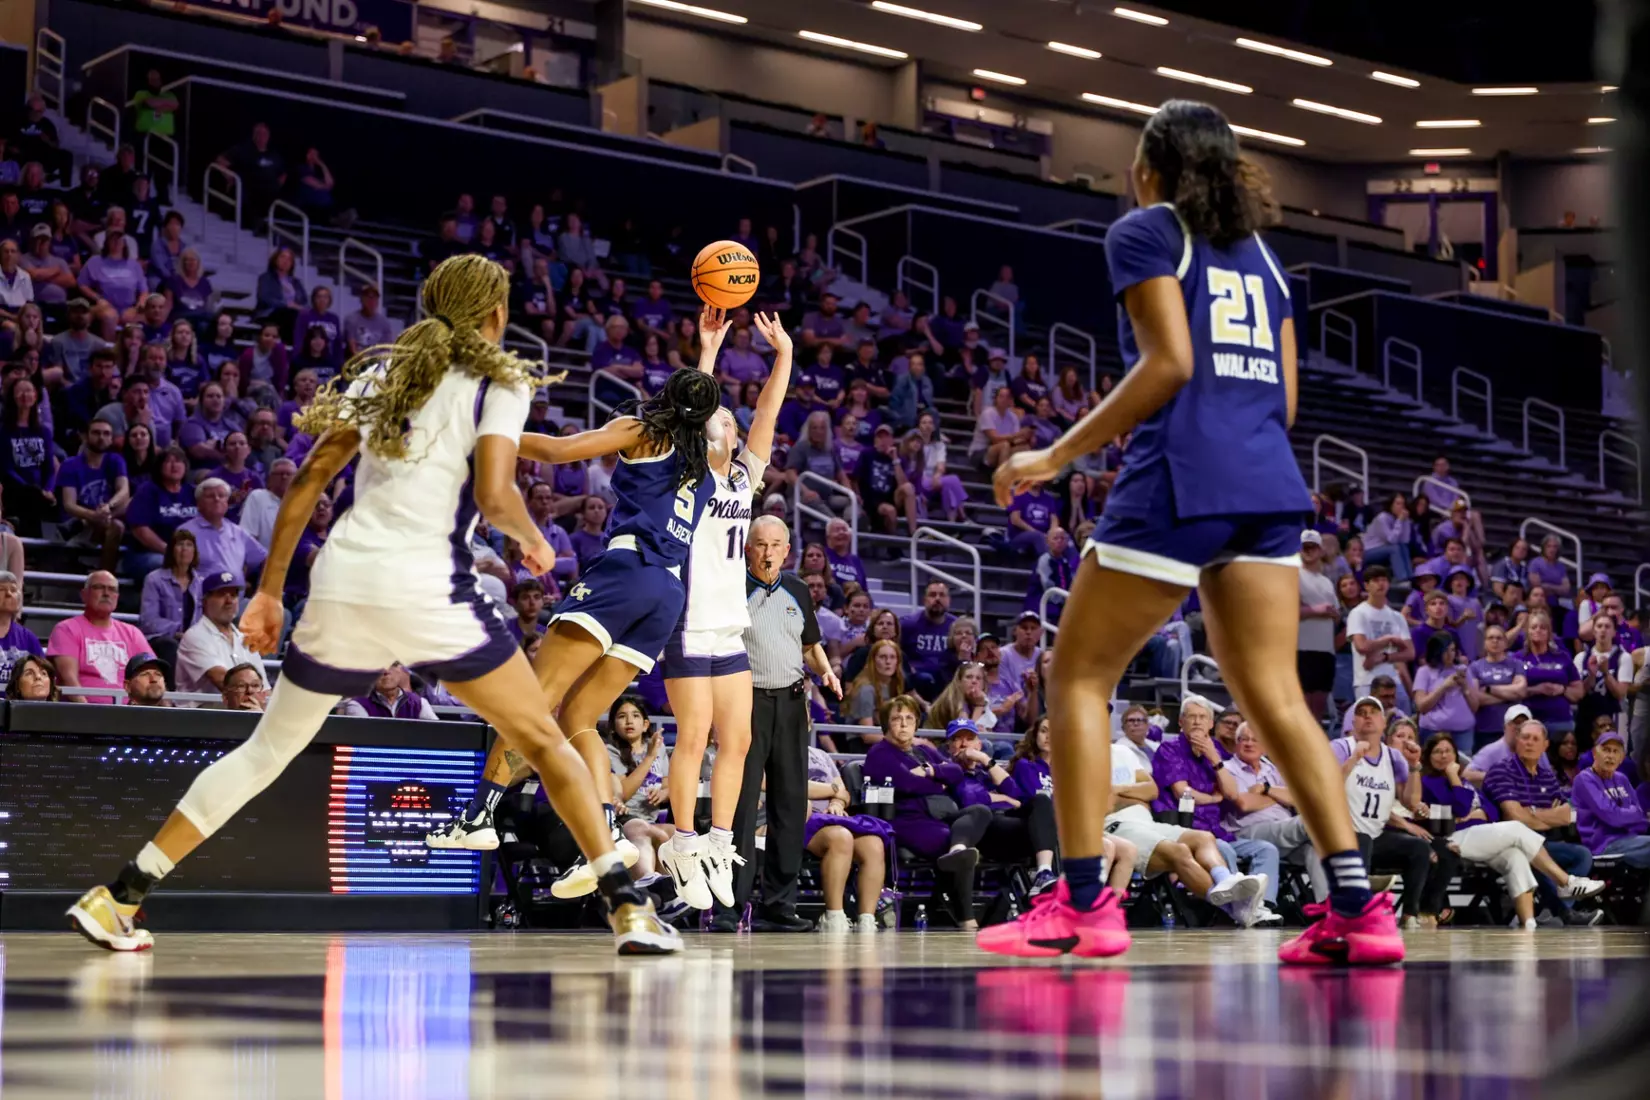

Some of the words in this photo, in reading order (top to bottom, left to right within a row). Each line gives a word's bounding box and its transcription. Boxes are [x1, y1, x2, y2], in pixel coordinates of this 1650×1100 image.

[132, 209, 149, 234] 7
[716, 252, 757, 265] Wilson
[728, 274, 757, 285] NCAA
[1207, 266, 1275, 352] 21
[1212, 352, 1279, 384] WALKER
[674, 477, 697, 526] 5
[726, 524, 744, 561] 11
[1361, 792, 1380, 819] 11
